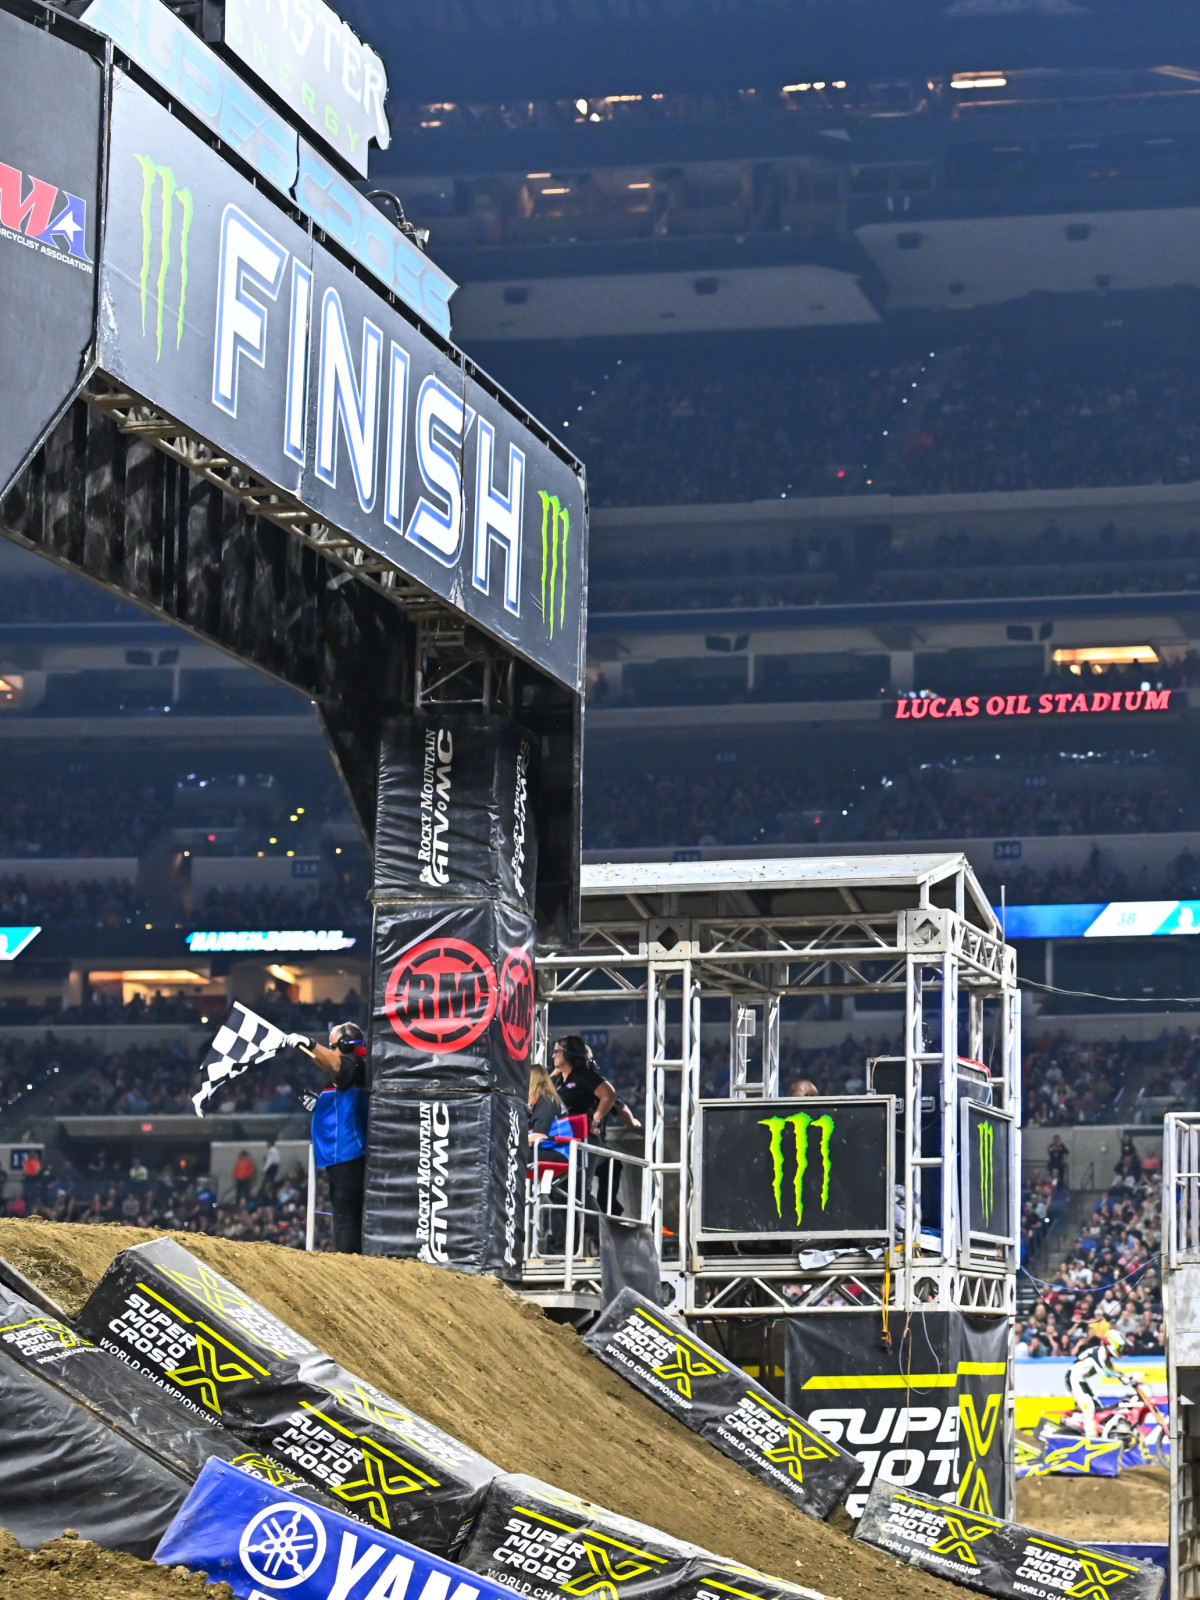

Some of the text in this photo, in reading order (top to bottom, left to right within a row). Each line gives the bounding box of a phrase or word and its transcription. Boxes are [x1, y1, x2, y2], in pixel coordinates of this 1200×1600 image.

[229, 14, 360, 153] ENERGY
[267, 0, 391, 150] STER
[40, 244, 93, 274] ASSOCIATION
[212, 202, 526, 619] FINISH
[894, 689, 1172, 719] LUCAS OIL STADIUM
[417, 728, 436, 862] ROCKY MOUNTAIN
[995, 842, 1020, 857] 340
[1116, 912, 1136, 926] 38
[406, 971, 478, 1020] RM
[416, 1101, 432, 1241] ROCKY MOUNTAIN
[3, 1326, 48, 1343] SUPER
[15, 1333, 54, 1349] MOTO
[121, 1309, 186, 1360] MOTO
[124, 1293, 197, 1351] SUPER
[626, 1315, 677, 1354] SUPER
[21, 1341, 65, 1356] CROSS
[108, 1318, 180, 1372] CROSS
[612, 1332, 664, 1369] CROSS
[622, 1326, 669, 1361] MOTO
[99, 1337, 225, 1430] WORLD CHAMPIONSHIP
[605, 1344, 693, 1410] WORLD CHAMPIONSHIP
[724, 1414, 775, 1452] CROSS
[732, 1408, 780, 1444] MOTO
[737, 1398, 789, 1437] SUPER
[282, 1428, 353, 1475] MOTO
[286, 1412, 364, 1465] SUPER
[271, 1437, 345, 1488] CROSS
[716, 1426, 805, 1494] WORLD CHAMPIONSHIP
[880, 1522, 938, 1547] CROSS
[887, 1514, 939, 1538] MOTO
[888, 1502, 948, 1529] SUPER
[503, 1535, 577, 1572] MOTO
[504, 1518, 587, 1559] SUPER
[877, 1536, 982, 1577] WORLD CHAMPIONSHIP
[492, 1547, 573, 1585] CROSS
[1022, 1545, 1084, 1572] SUPER
[1022, 1556, 1076, 1581] MOTO
[486, 1568, 533, 1596] WORLD
[1012, 1581, 1047, 1599] WORLD
[1015, 1566, 1074, 1591] CROSS
